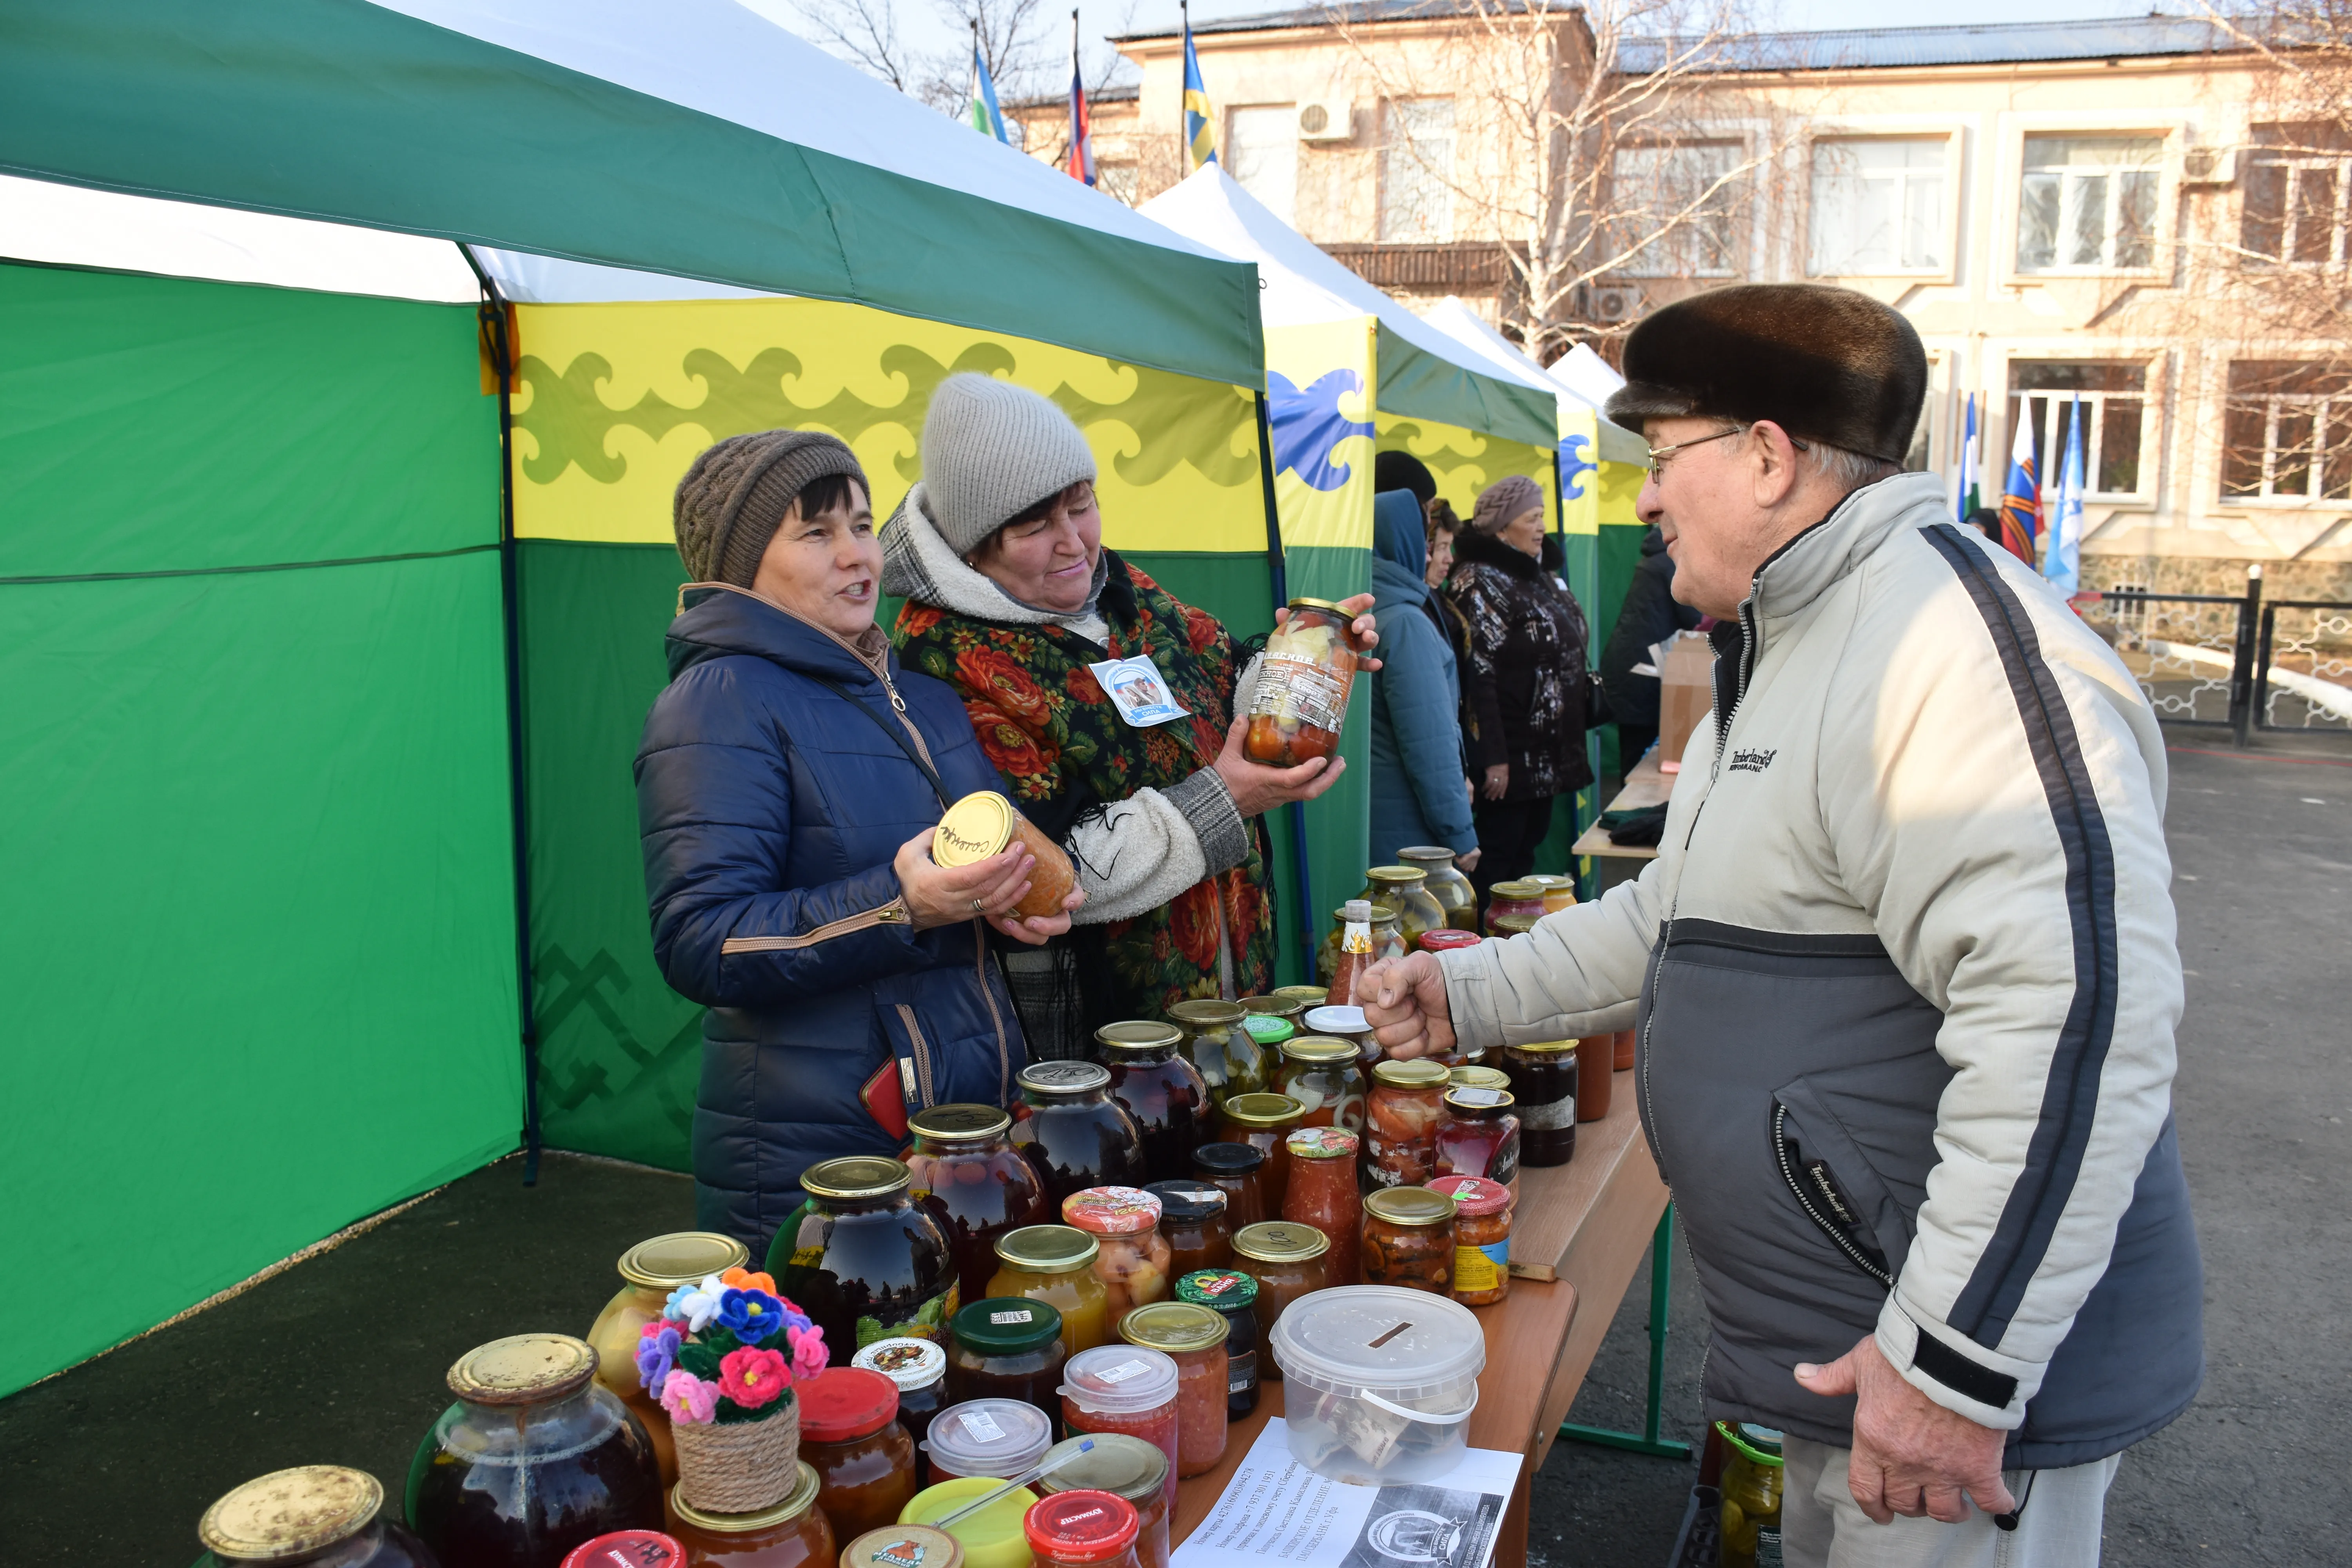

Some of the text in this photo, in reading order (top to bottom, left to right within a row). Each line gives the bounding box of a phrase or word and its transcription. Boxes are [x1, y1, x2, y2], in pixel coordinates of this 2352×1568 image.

[1297, 684, 1322, 698] СПОРТ
[1042, 1067, 1095, 1079] 250
[1210, 1278, 1235, 1293] ВАНЯ
[871, 1342, 915, 1356] отборные
[1261, 1470, 1276, 1483] 1931
[1255, 1484, 1268, 1494] 301
[1108, 1493, 1124, 1502] ХЛОПОК
[1249, 1494, 1261, 1505] 937
[1193, 1467, 1254, 1544] Номер карты 4276160903894278
[1255, 1501, 1278, 1529] лицевому
[1271, 1486, 1286, 1501] счету
[1060, 1508, 1103, 1525] КУХМАСТЕР
[1255, 1532, 1282, 1555] Получатель
[1275, 1506, 1296, 1532] Светлана
[1289, 1476, 1312, 1506] Камилевна
[1278, 1525, 1310, 1559] БАШКИРСКОЕ
[1303, 1485, 1330, 1524] ОТДЕЛЕНИЕ
[1230, 1514, 1251, 1535] телефона
[1083, 1533, 1119, 1545] ПРОИЗВЕДЕНО
[1215, 1535, 1236, 1548] Номер
[1296, 1550, 1312, 1562] ПАО
[1306, 1523, 1330, 1551] СБЕРБАНК
[1434, 1527, 1446, 1547] ВМЕСТЕ
[1439, 1534, 1450, 1550] СИЛА
[1471, 1530, 1481, 1544] ИМЕНИ
[873, 1552, 922, 1565] МЕДВЕДЬ
[1466, 1544, 1477, 1560] ШТАБОМ
